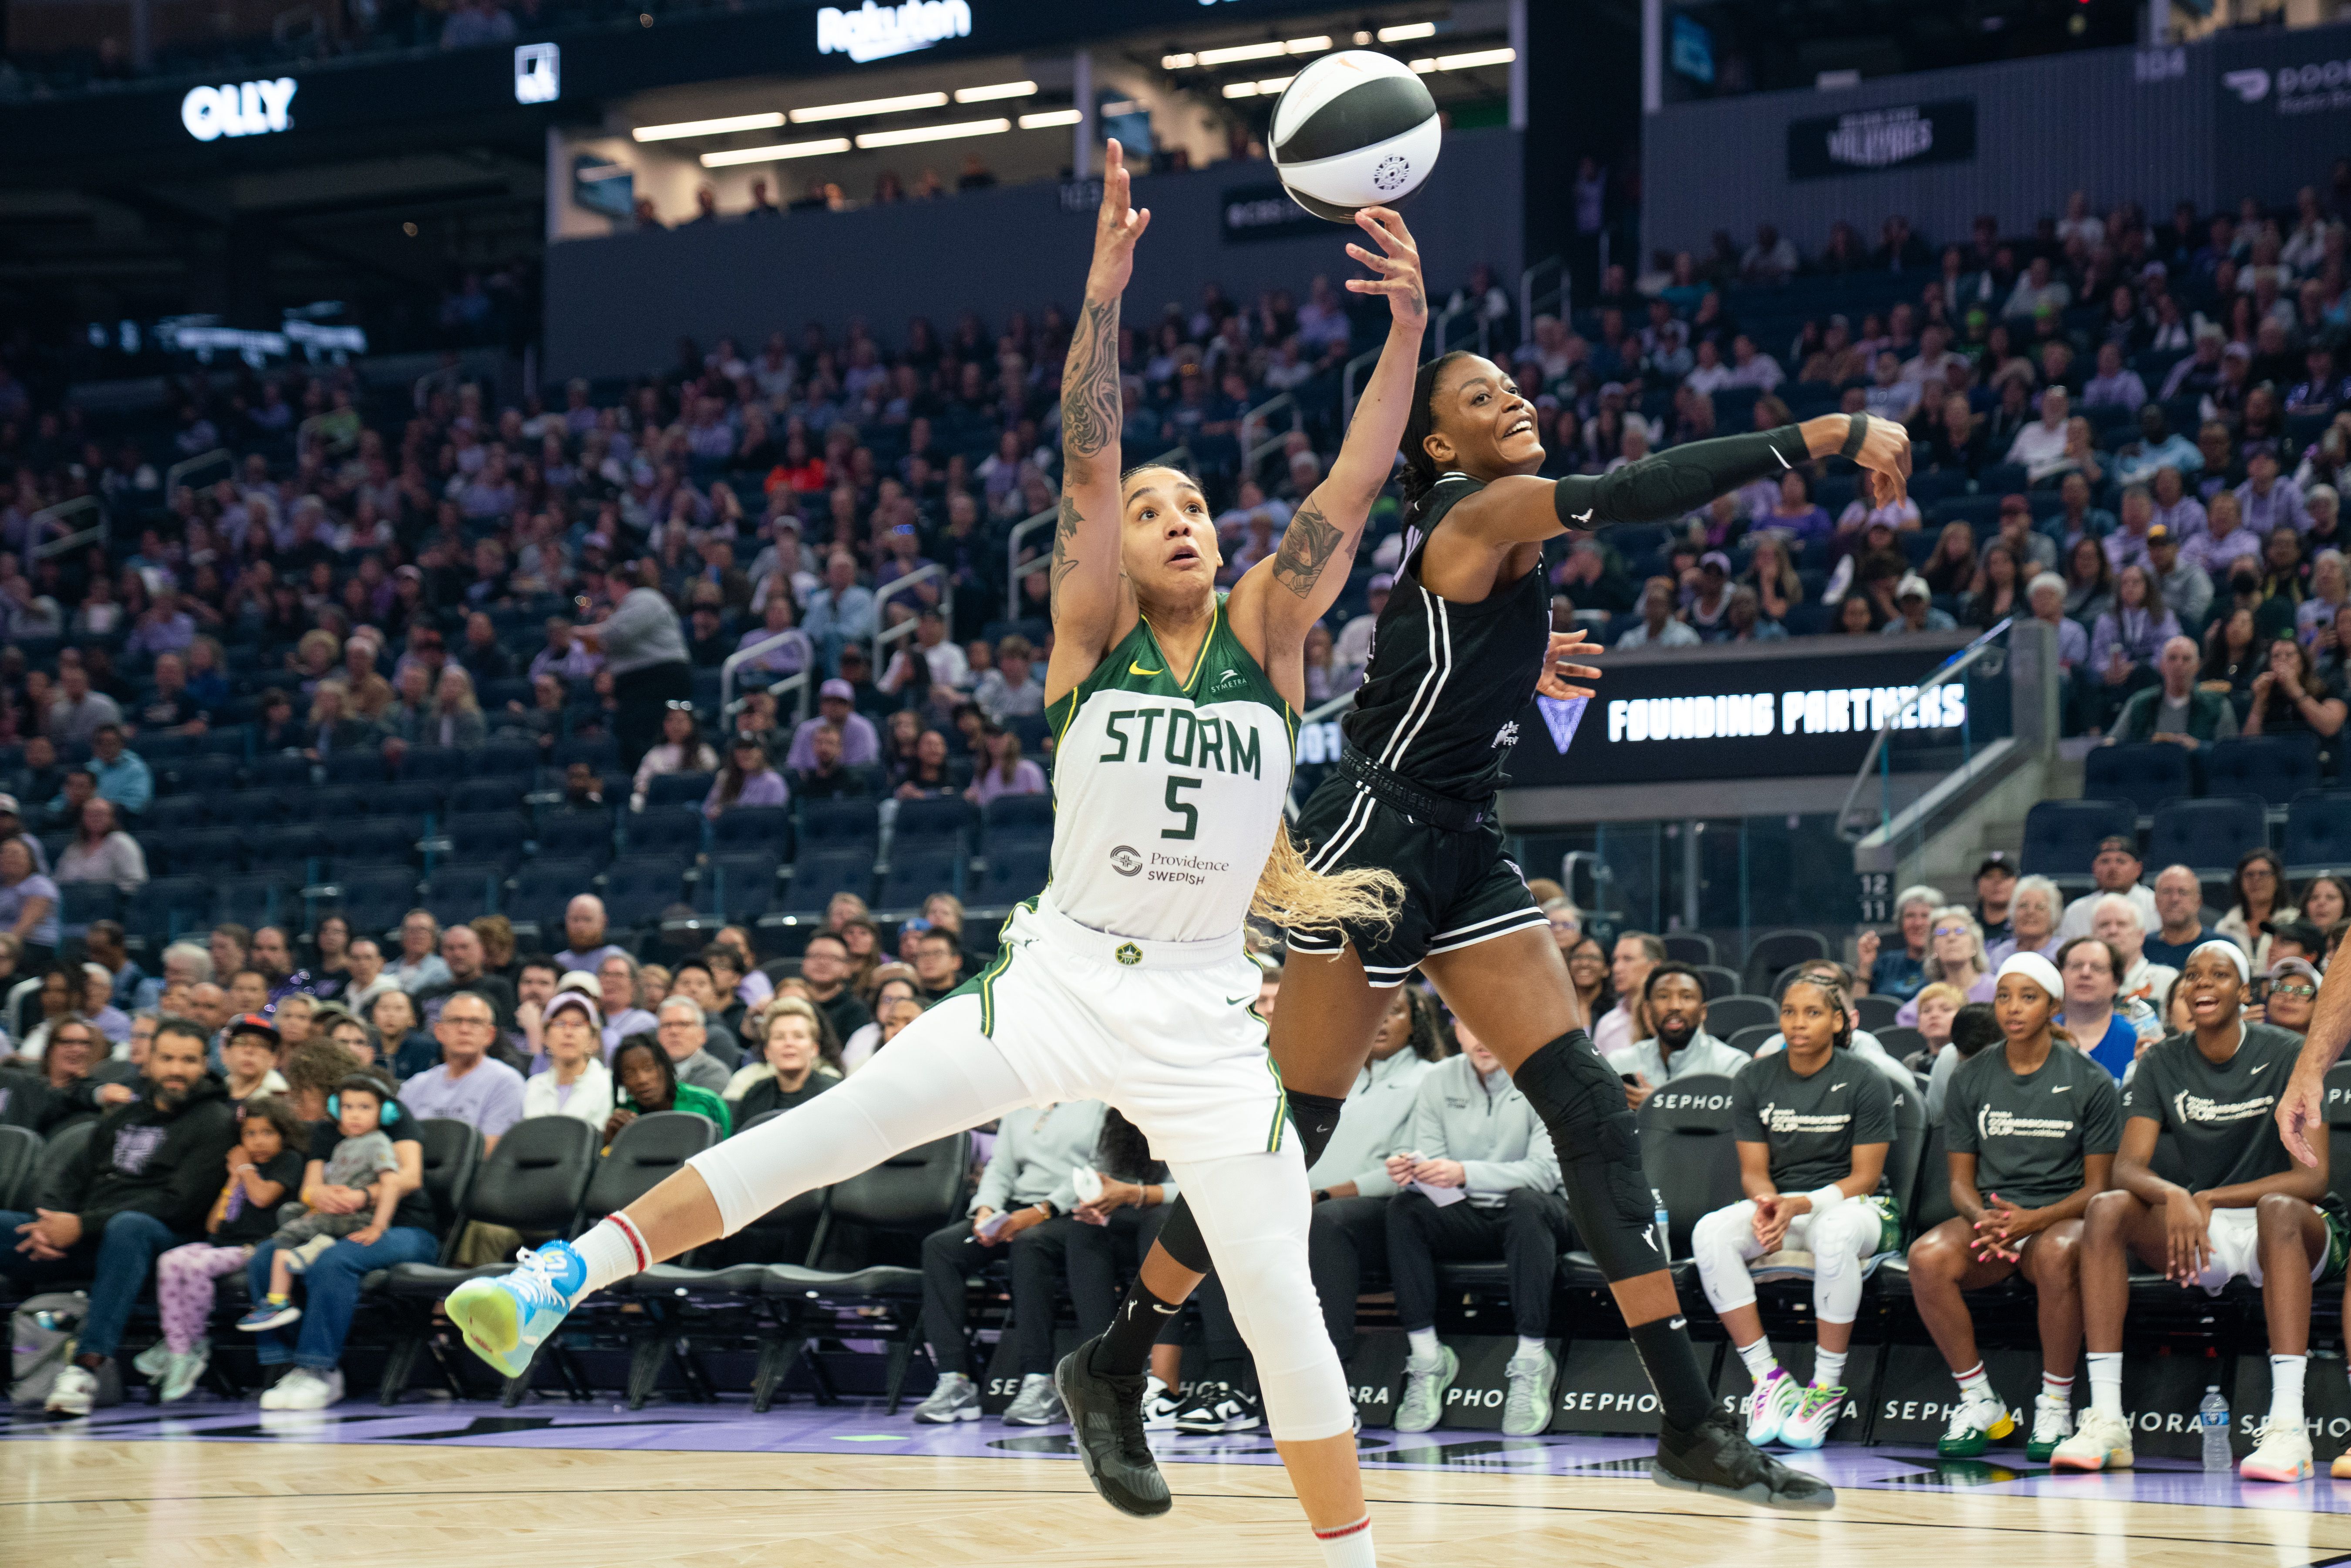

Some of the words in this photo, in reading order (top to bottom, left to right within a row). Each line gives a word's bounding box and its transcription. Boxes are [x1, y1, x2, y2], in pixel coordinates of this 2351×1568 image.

[817, 0, 972, 55] Rakuten
[182, 77, 299, 142] OLLY
[1211, 678, 1247, 693] SYMETRA
[1608, 693, 1775, 742] FOUNDING
[1099, 708, 1261, 781] STORM
[1161, 775, 1202, 840] 5
[1151, 852, 1229, 871] Providence
[1148, 871, 1205, 885] SWEDISH
[1861, 874, 1888, 895] 12
[1652, 1093, 1734, 1110] SEPHOR
[1563, 1392, 1658, 1413] SEPHO
[1884, 1400, 2024, 1427] SEPHA
